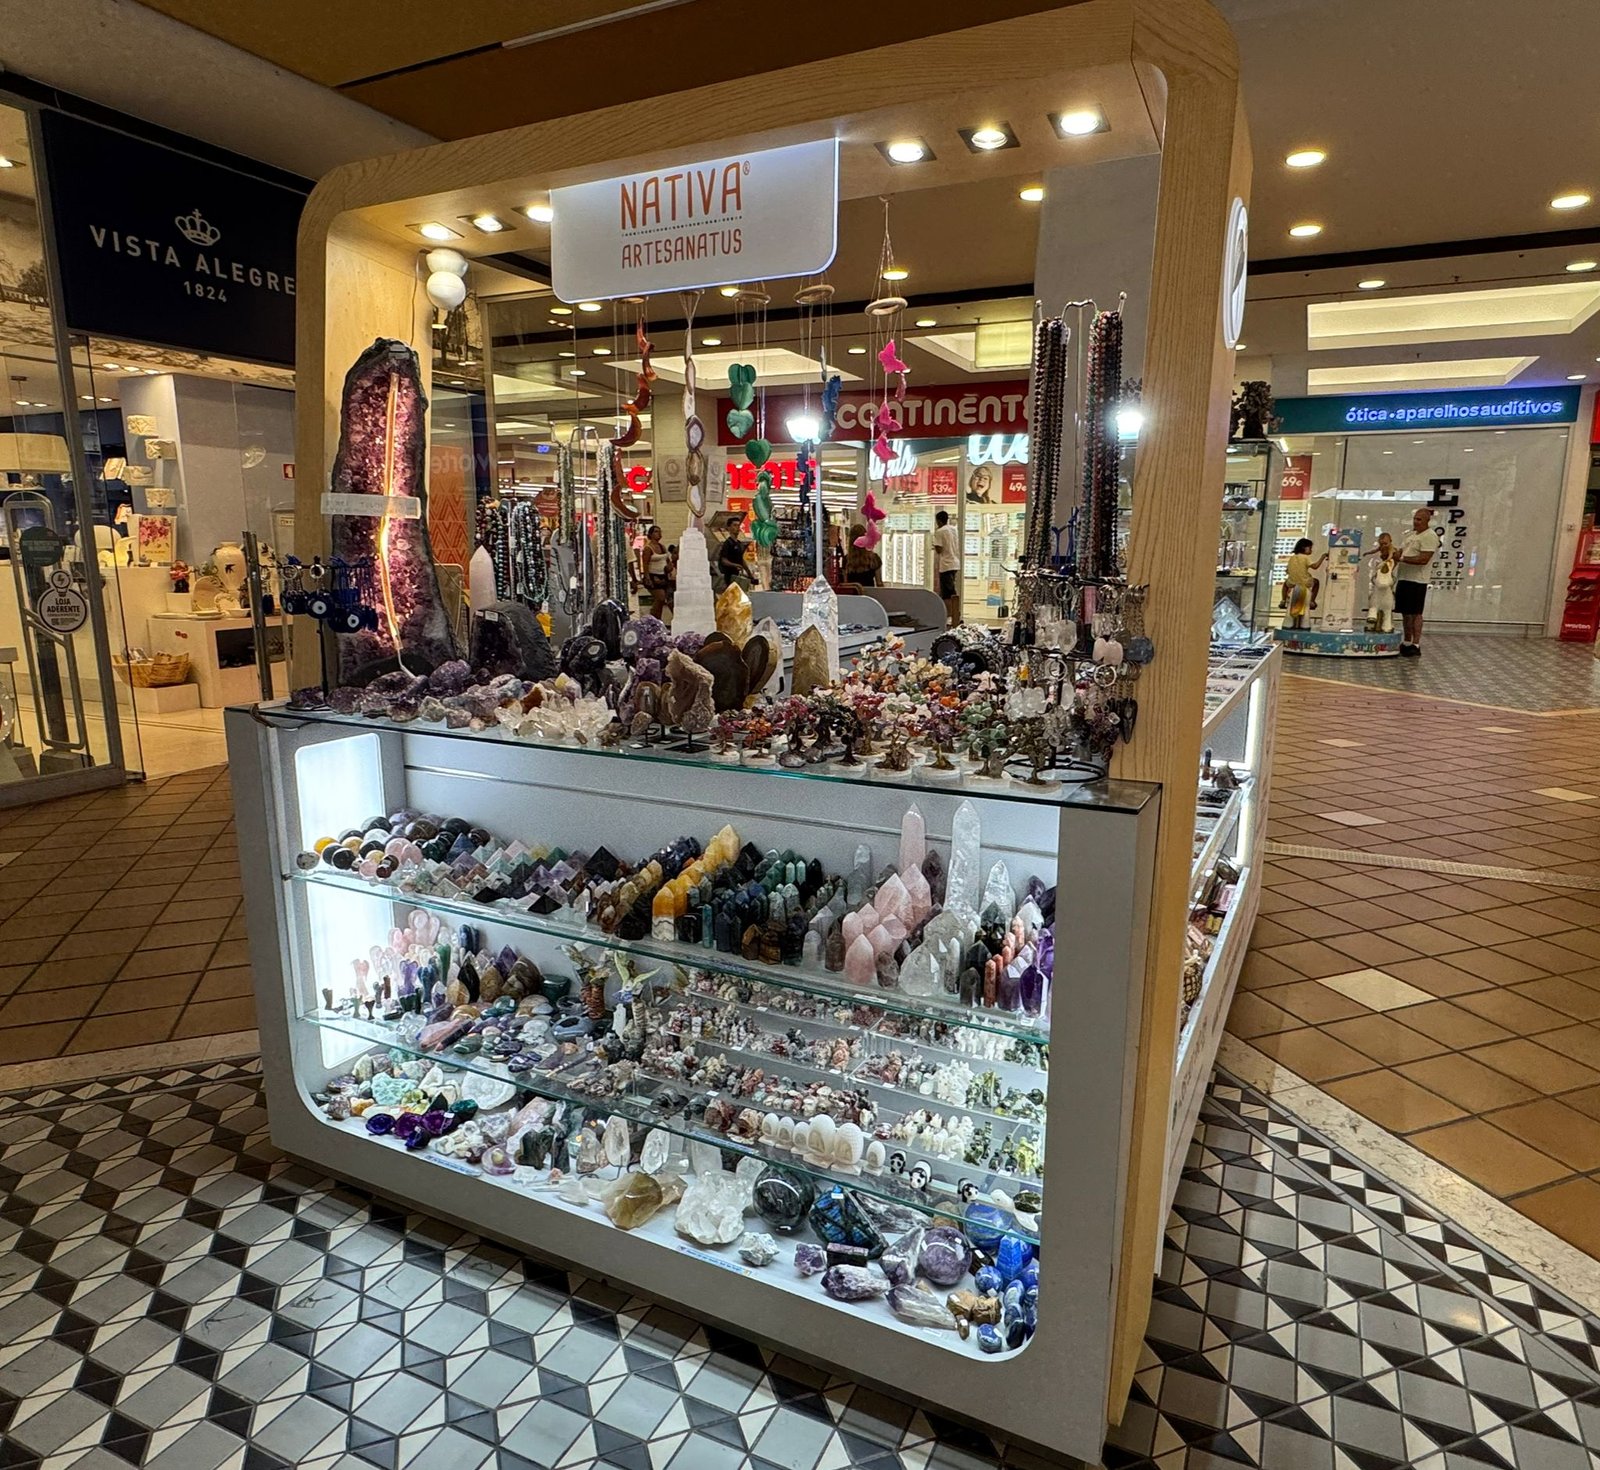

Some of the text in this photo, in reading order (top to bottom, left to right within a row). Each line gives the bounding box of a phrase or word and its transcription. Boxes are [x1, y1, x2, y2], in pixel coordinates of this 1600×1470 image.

[621, 229, 742, 269] ARTESANATUS
[89, 224, 296, 296] VISTA ALEGRE
[183, 280, 228, 303] 1824
[1345, 406, 1387, 422] ótica
[1427, 479, 1460, 506] E
[1448, 510, 1465, 523] P
[1455, 527, 1467, 537] Z
[46, 605, 81, 613] ADERENTE
